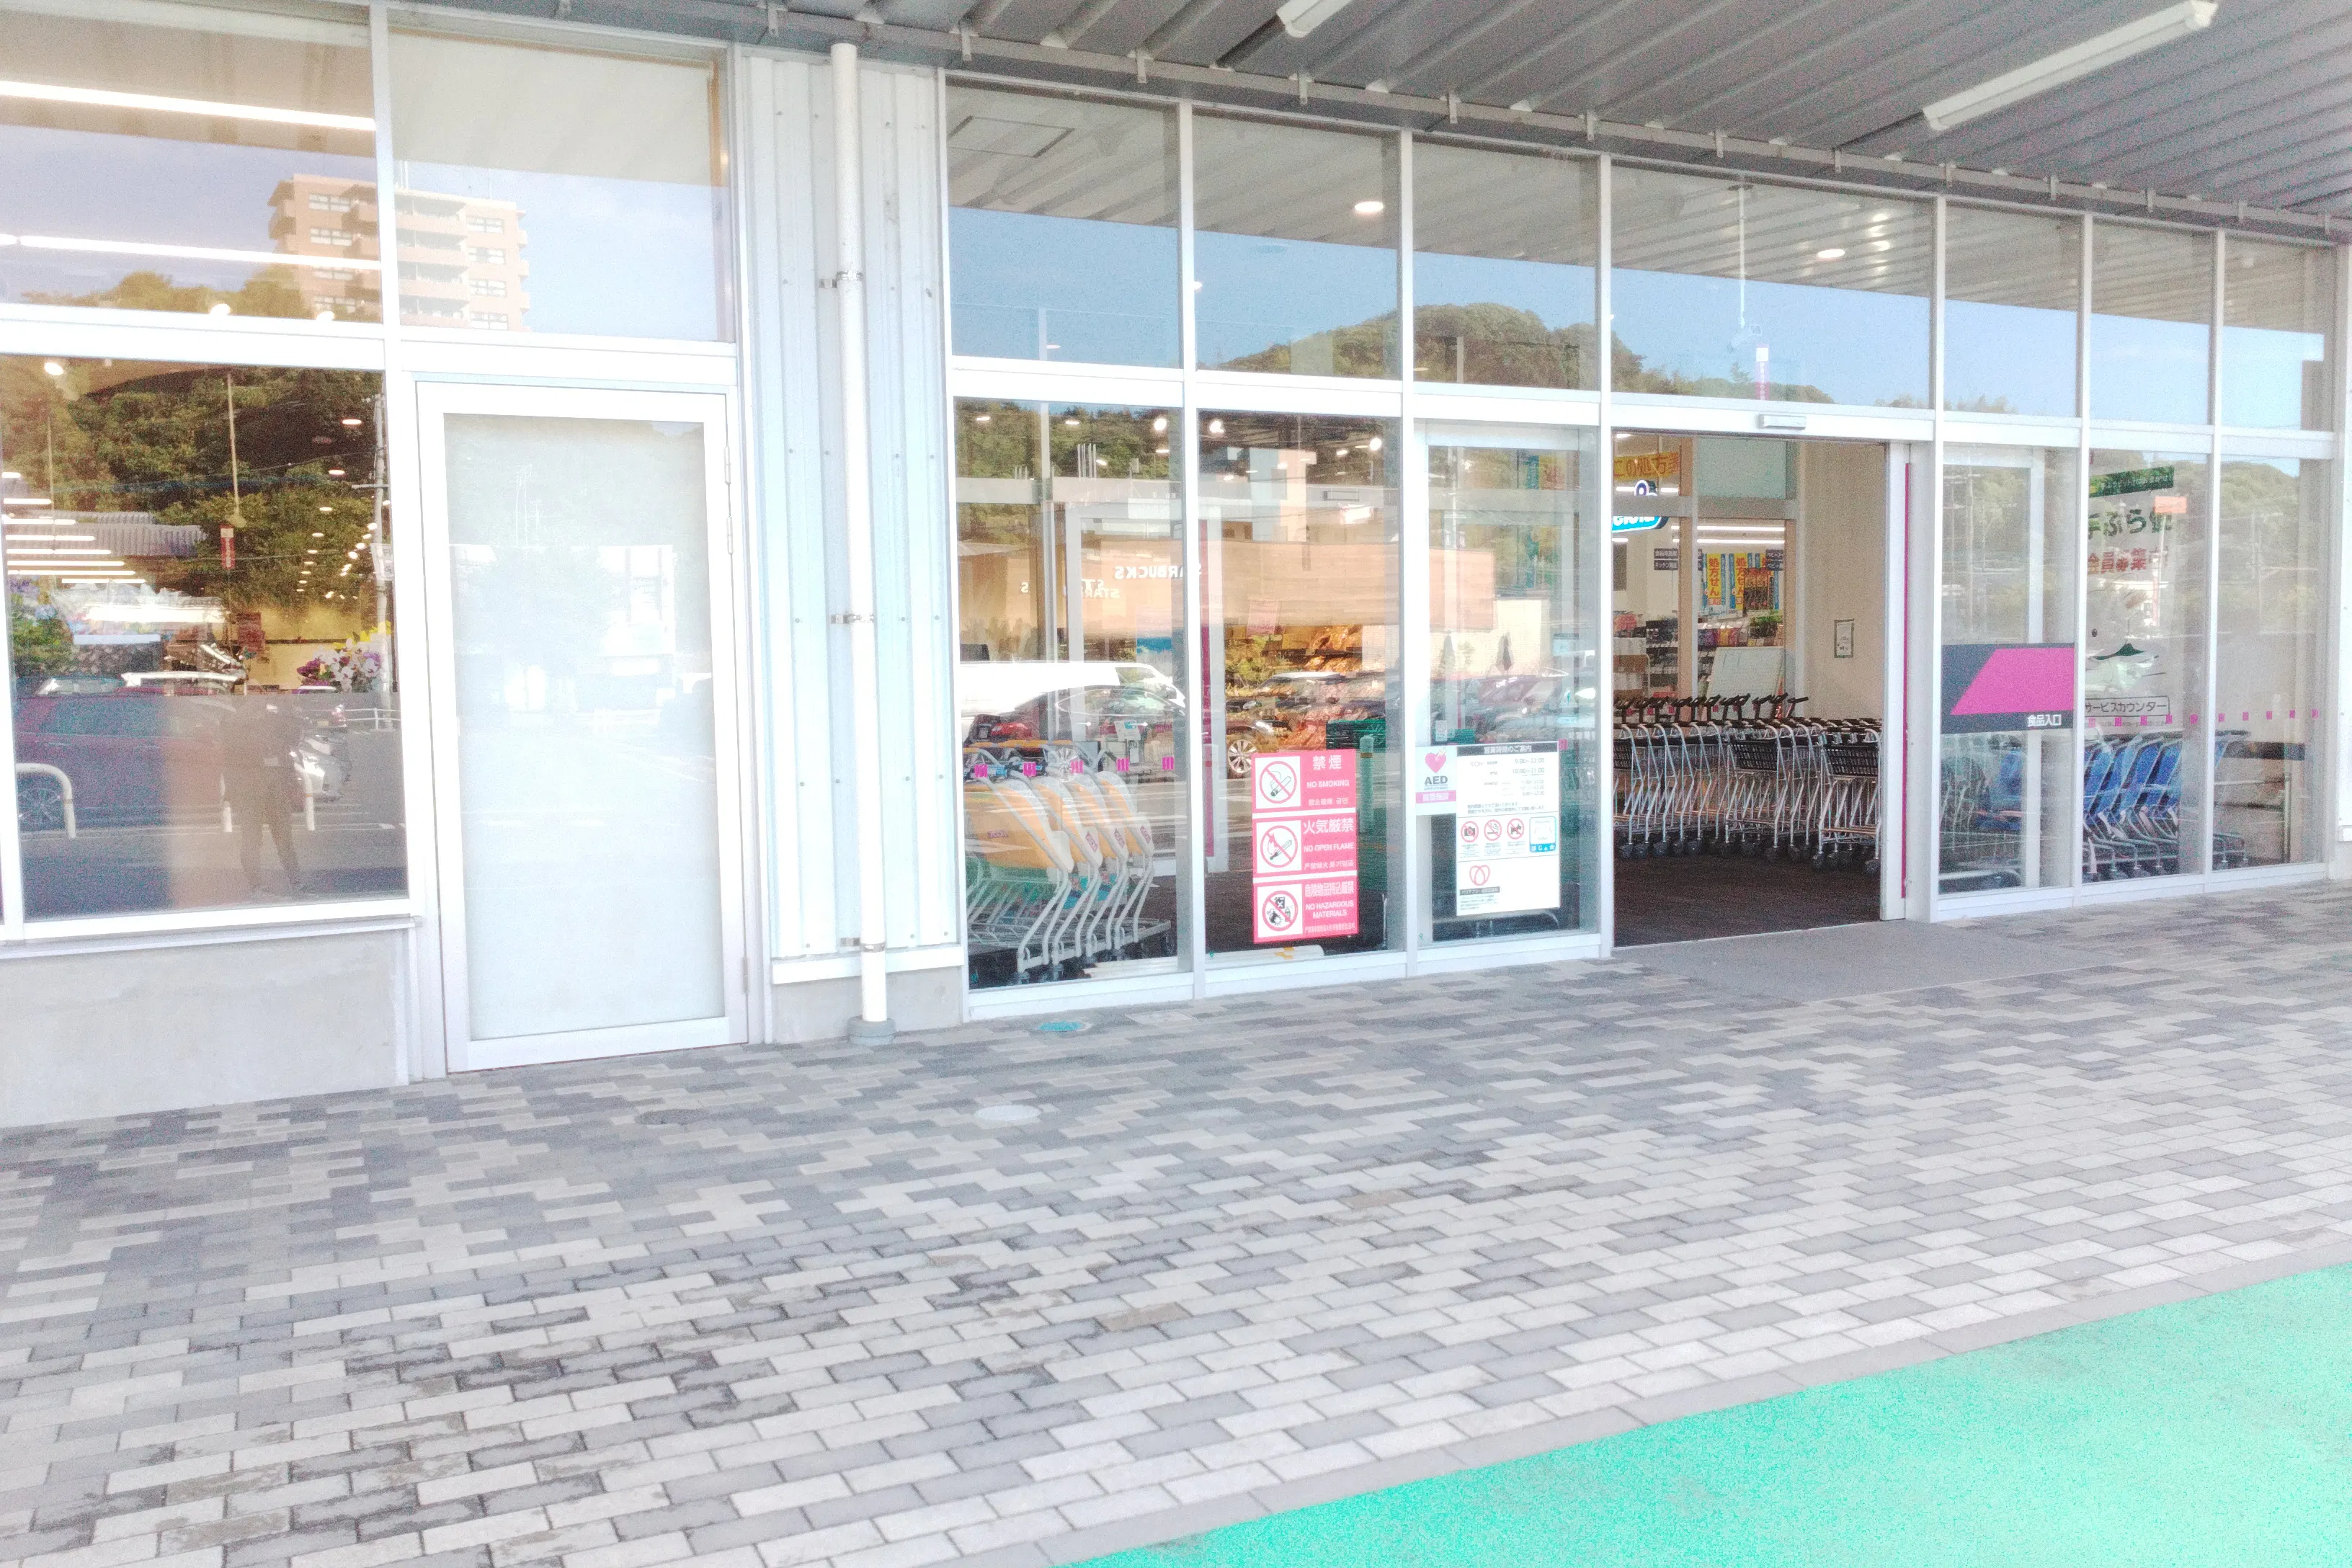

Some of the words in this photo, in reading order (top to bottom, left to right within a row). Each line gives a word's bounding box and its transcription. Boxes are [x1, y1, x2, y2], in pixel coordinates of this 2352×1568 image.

[2027, 715, 2062, 727] 食品入口
[1425, 775, 1448, 785] AED
[1303, 817, 1354, 834] 火気厳禁
[1333, 842, 1355, 850] FLAME
[1316, 899, 1354, 909] HAZARDOUS
[1312, 909, 1348, 919] MATERIALS
